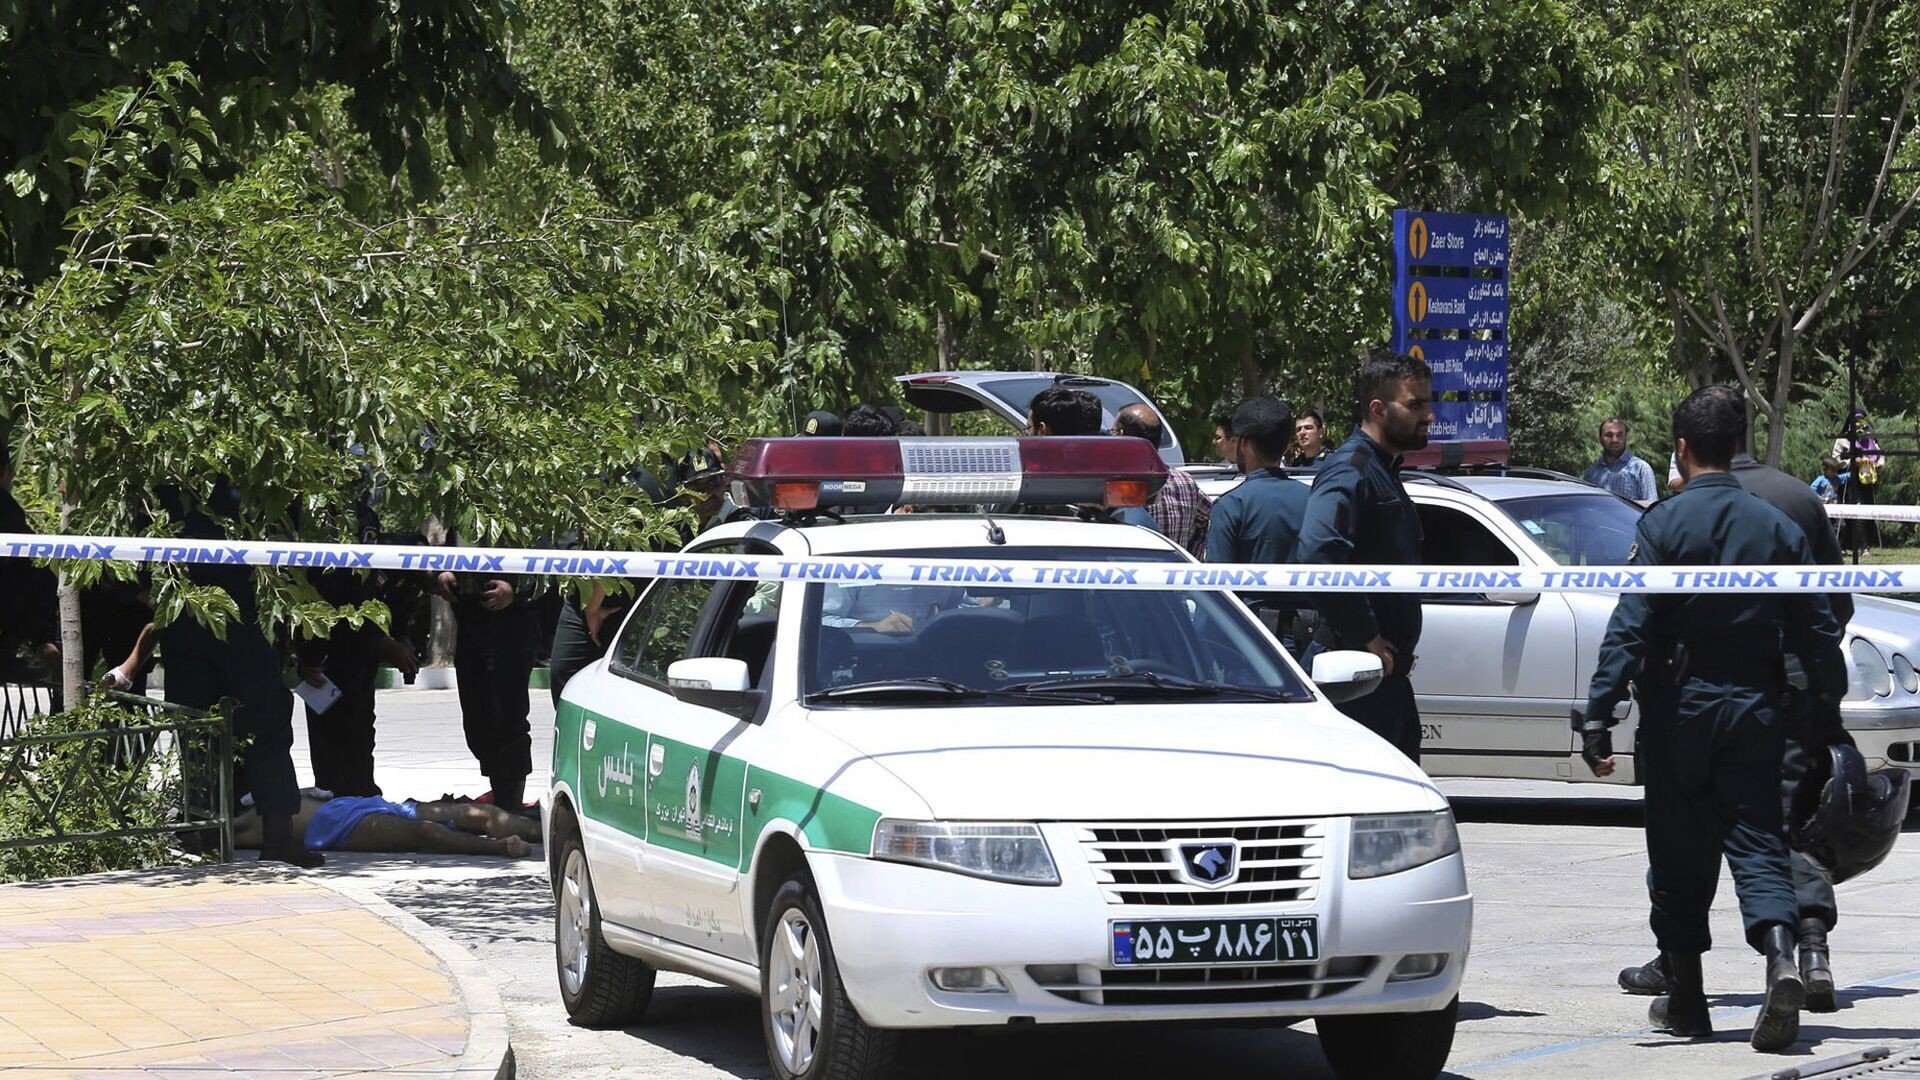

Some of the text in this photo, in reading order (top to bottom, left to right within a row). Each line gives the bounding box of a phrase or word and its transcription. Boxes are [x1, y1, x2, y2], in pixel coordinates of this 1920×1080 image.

[1431, 231, 1465, 249] Zaer Store
[1454, 298, 1466, 314] Bank
[1466, 402, 1503, 429] هتل آفتاب
[1442, 421, 1458, 436] Hotel
[7, 542, 1904, 588] TRINX TRINX TRINX TRINX TRINX TRINX TRINX TRINX TRINX TRINX TRINX TRINX TRINX TRINX TRINX
[598, 741, 634, 806] پلیس
[1281, 919, 1312, 928] ایران
